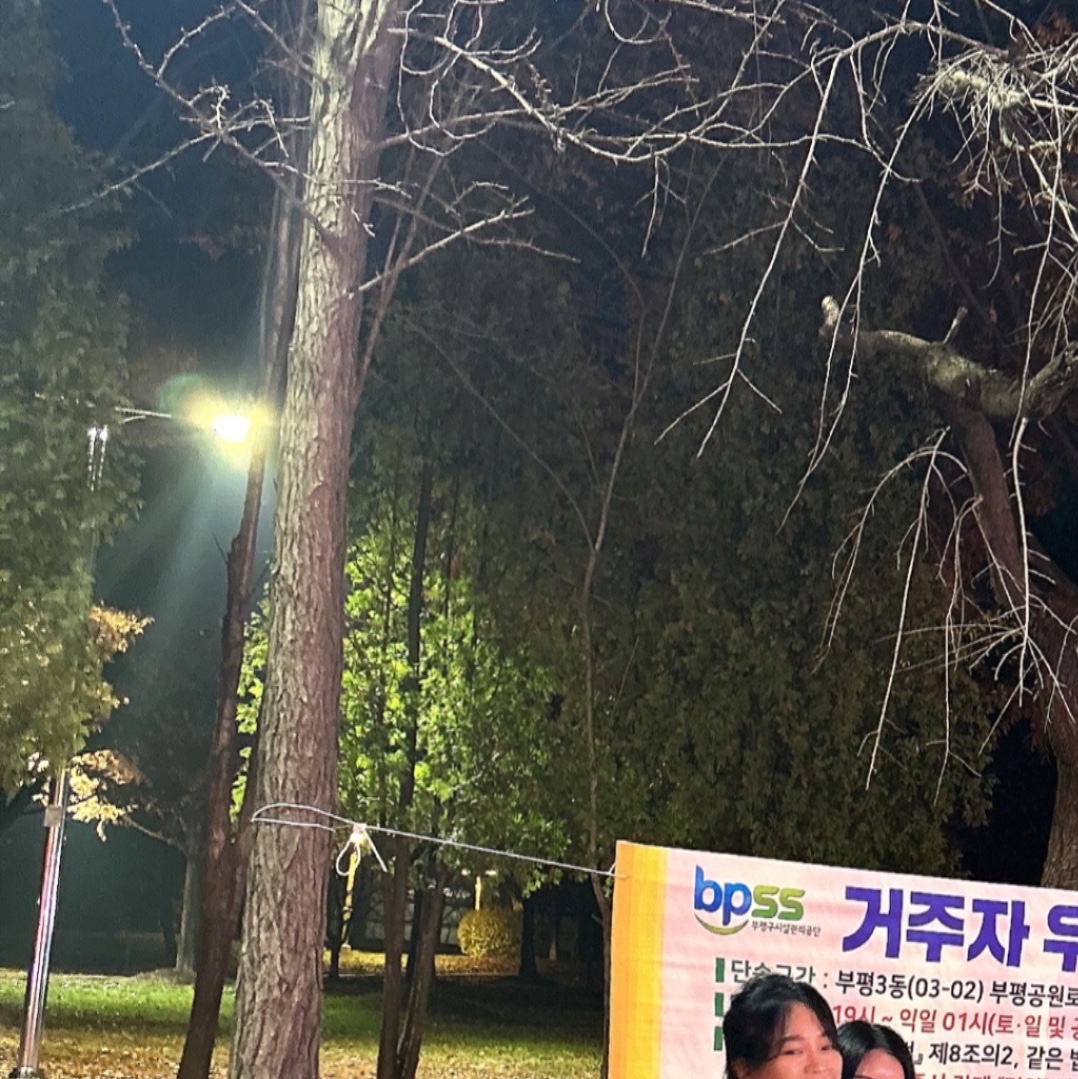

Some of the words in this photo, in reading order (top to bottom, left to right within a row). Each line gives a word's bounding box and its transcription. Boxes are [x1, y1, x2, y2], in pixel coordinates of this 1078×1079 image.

[694, 865, 805, 926] bpss
[842, 886, 1030, 967] 거주자
[835, 970, 984, 1004] 부평3동(03-02)
[900, 1008, 937, 1034] 익일
[1049, 1016, 1066, 1040] 및
[928, 1042, 1019, 1069] 제8조의2,
[1026, 1046, 1063, 1070] 같은
